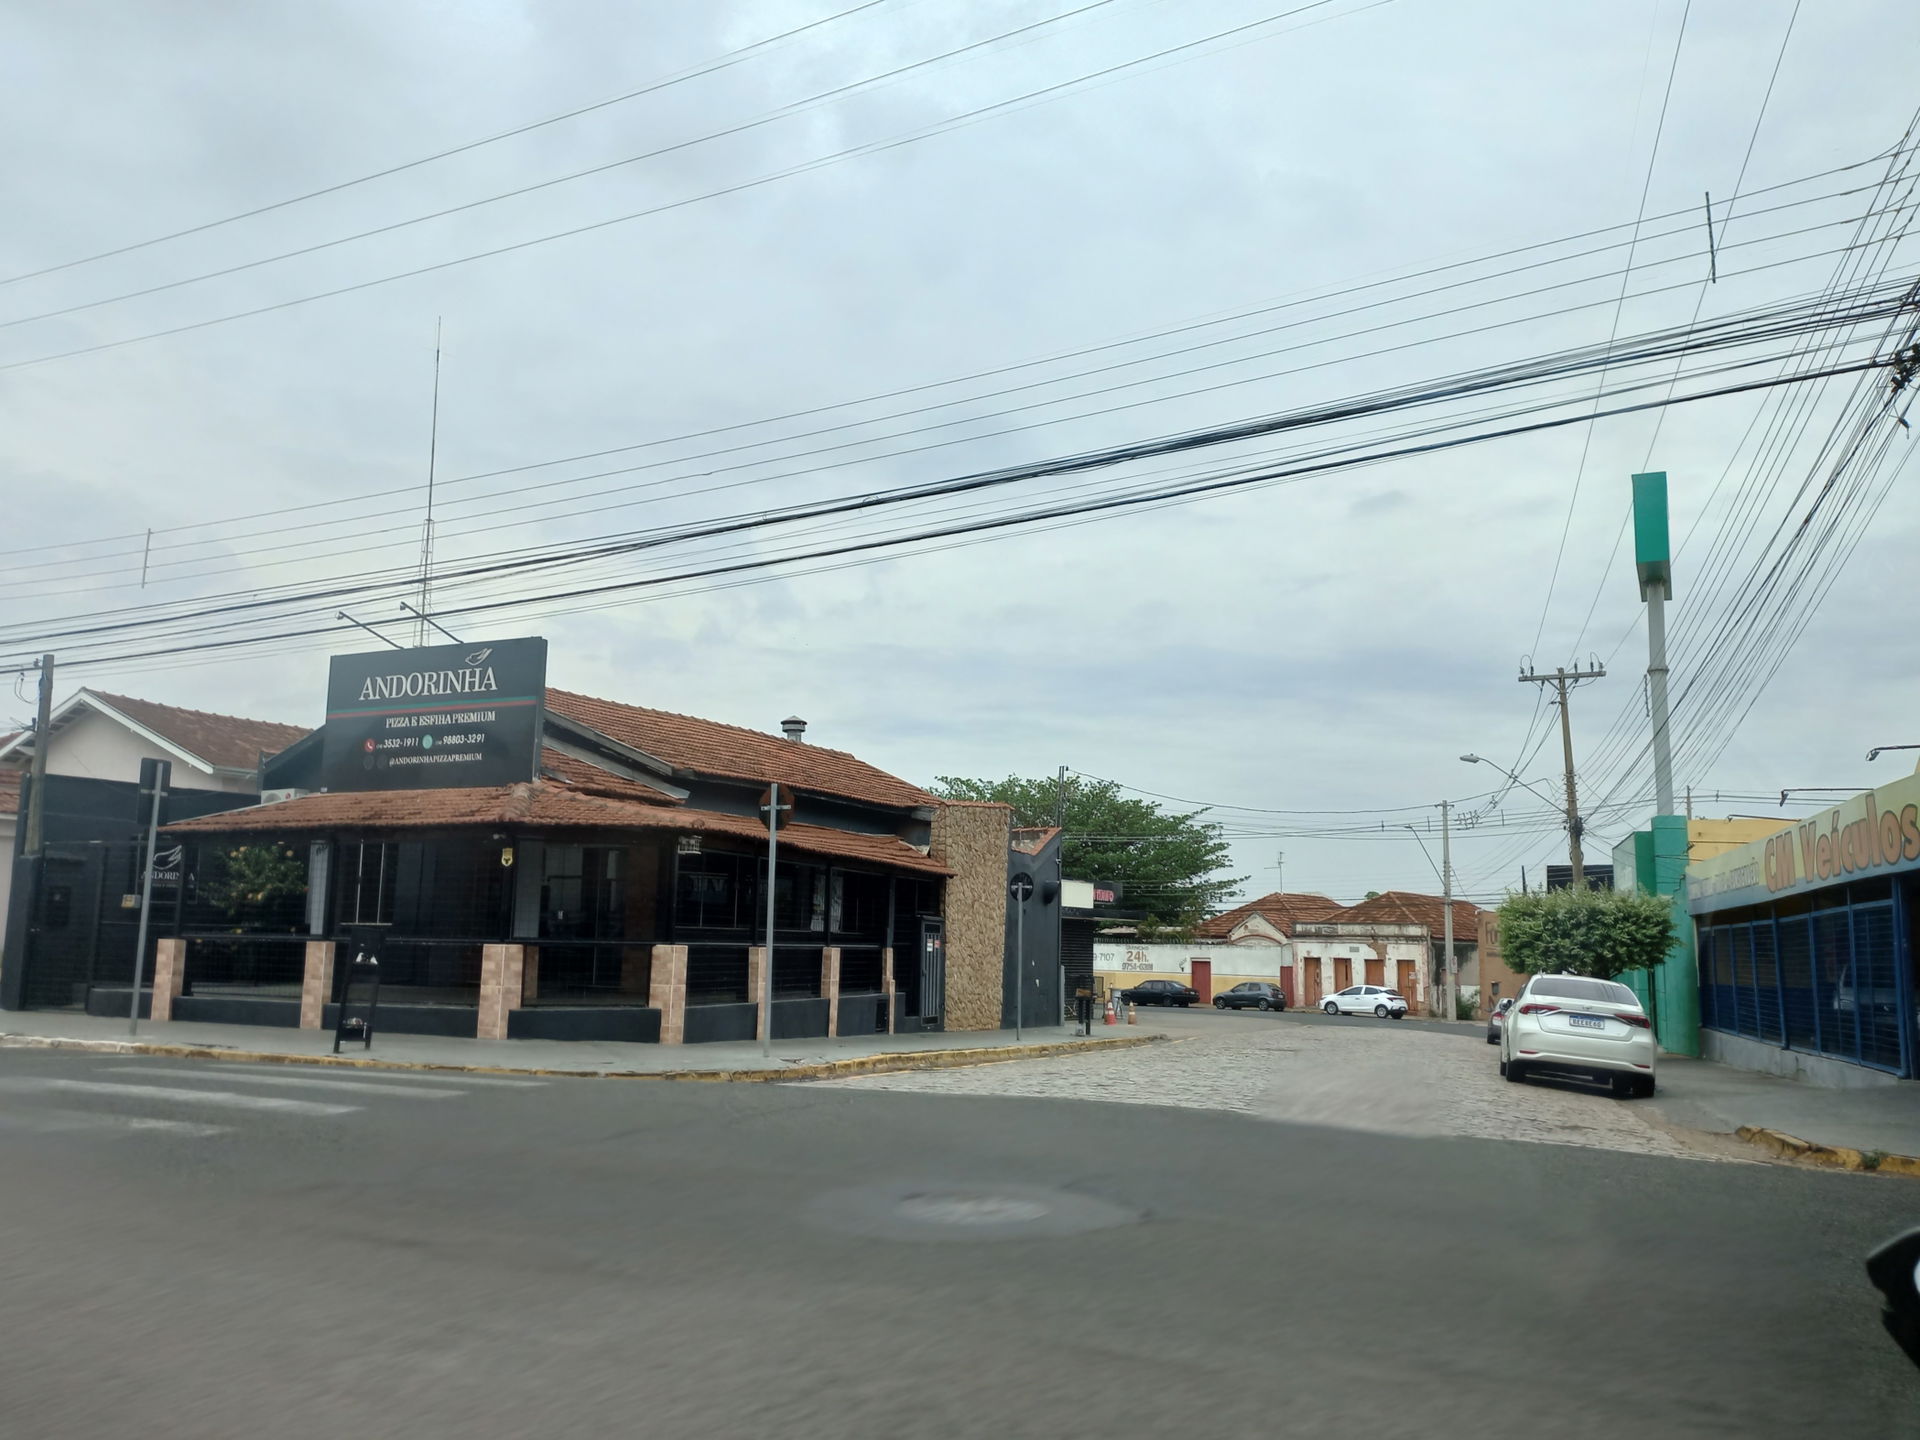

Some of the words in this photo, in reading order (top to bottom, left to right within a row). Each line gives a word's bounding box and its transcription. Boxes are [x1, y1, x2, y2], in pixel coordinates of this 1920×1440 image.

[359, 667, 498, 700] ANDORINHA
[386, 715, 411, 729] PIZZA
[411, 715, 418, 727] E
[418, 713, 451, 727] ESFIHA
[452, 711, 496, 724] PREMIUM
[383, 737, 419, 749] 3532-1911
[389, 753, 482, 767] @ANDORINHAPIZZAPREMIUM
[1764, 831, 1796, 893] CM
[1799, 794, 1920, 883] Veículos
